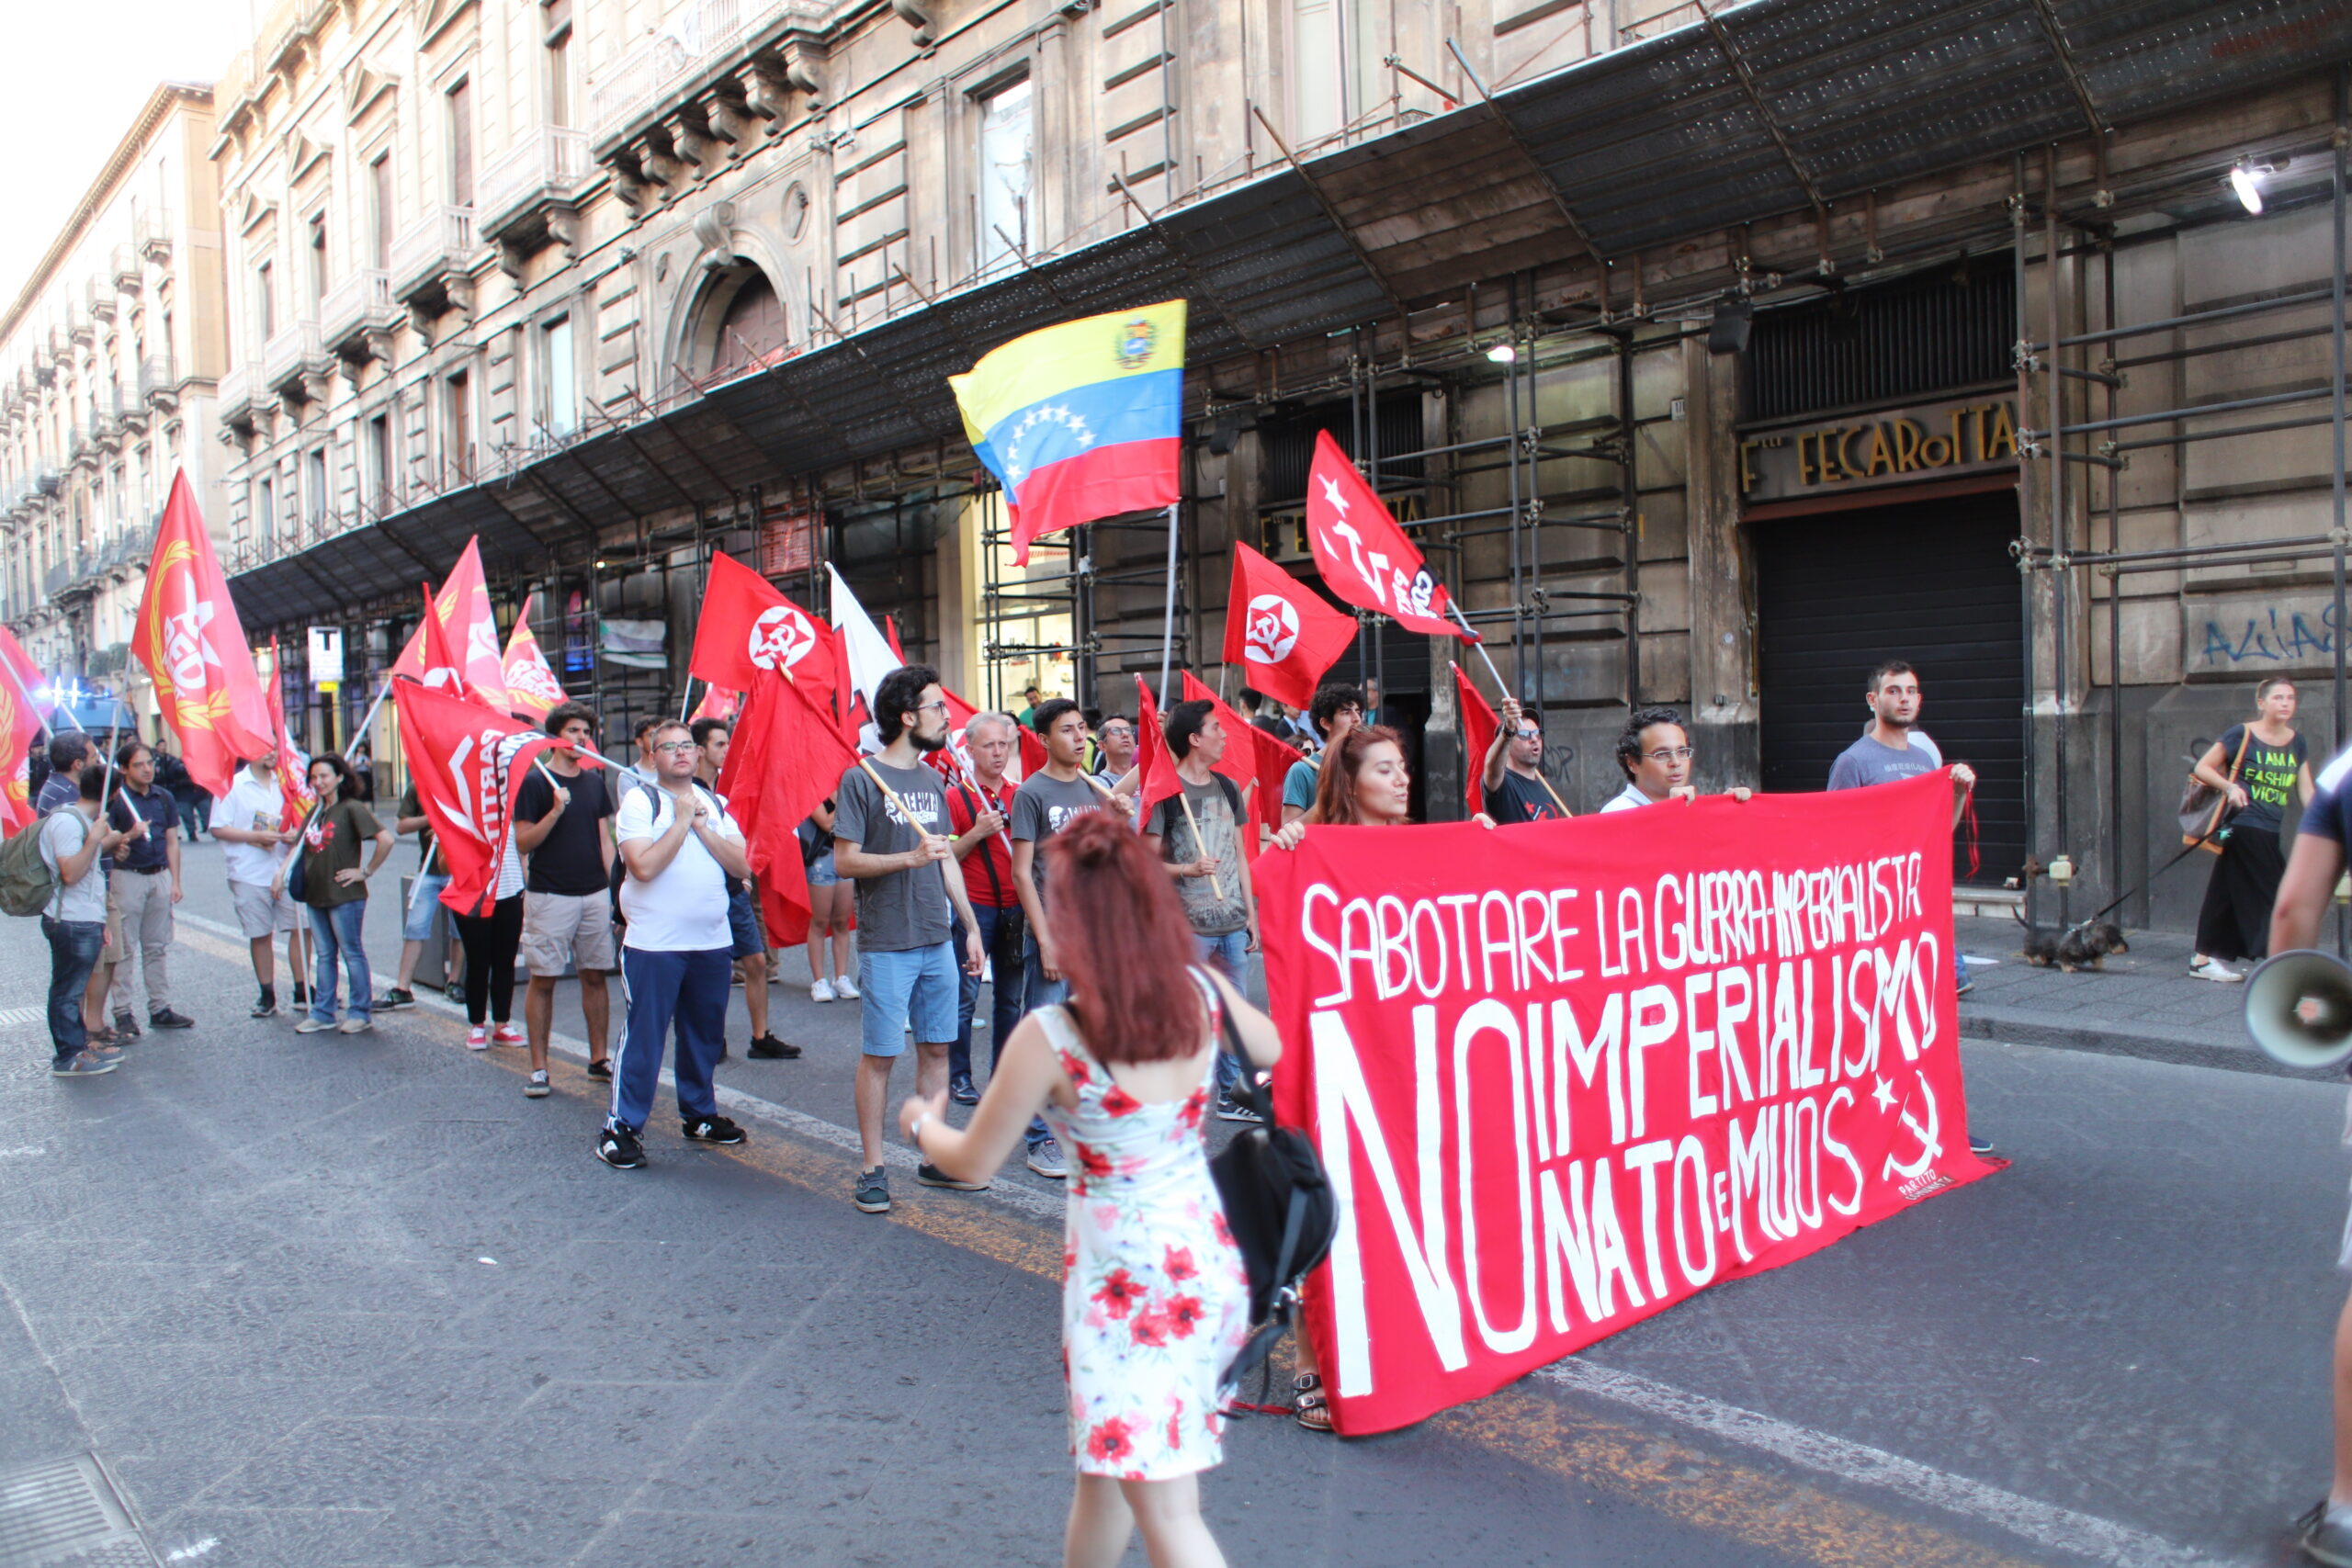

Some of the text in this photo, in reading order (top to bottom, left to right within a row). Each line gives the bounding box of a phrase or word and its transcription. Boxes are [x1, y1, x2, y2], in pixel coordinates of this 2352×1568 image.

[316, 629, 338, 651] T
[1302, 883, 1584, 1008] SABOTARE
[1595, 887, 1647, 977] LA
[1309, 931, 1939, 1397] NO IMPERIALISMO
[1539, 1134, 1717, 1334] NATO
[1728, 1086, 1863, 1263] MUOS
[1898, 1168, 1937, 1196] PARTITO
